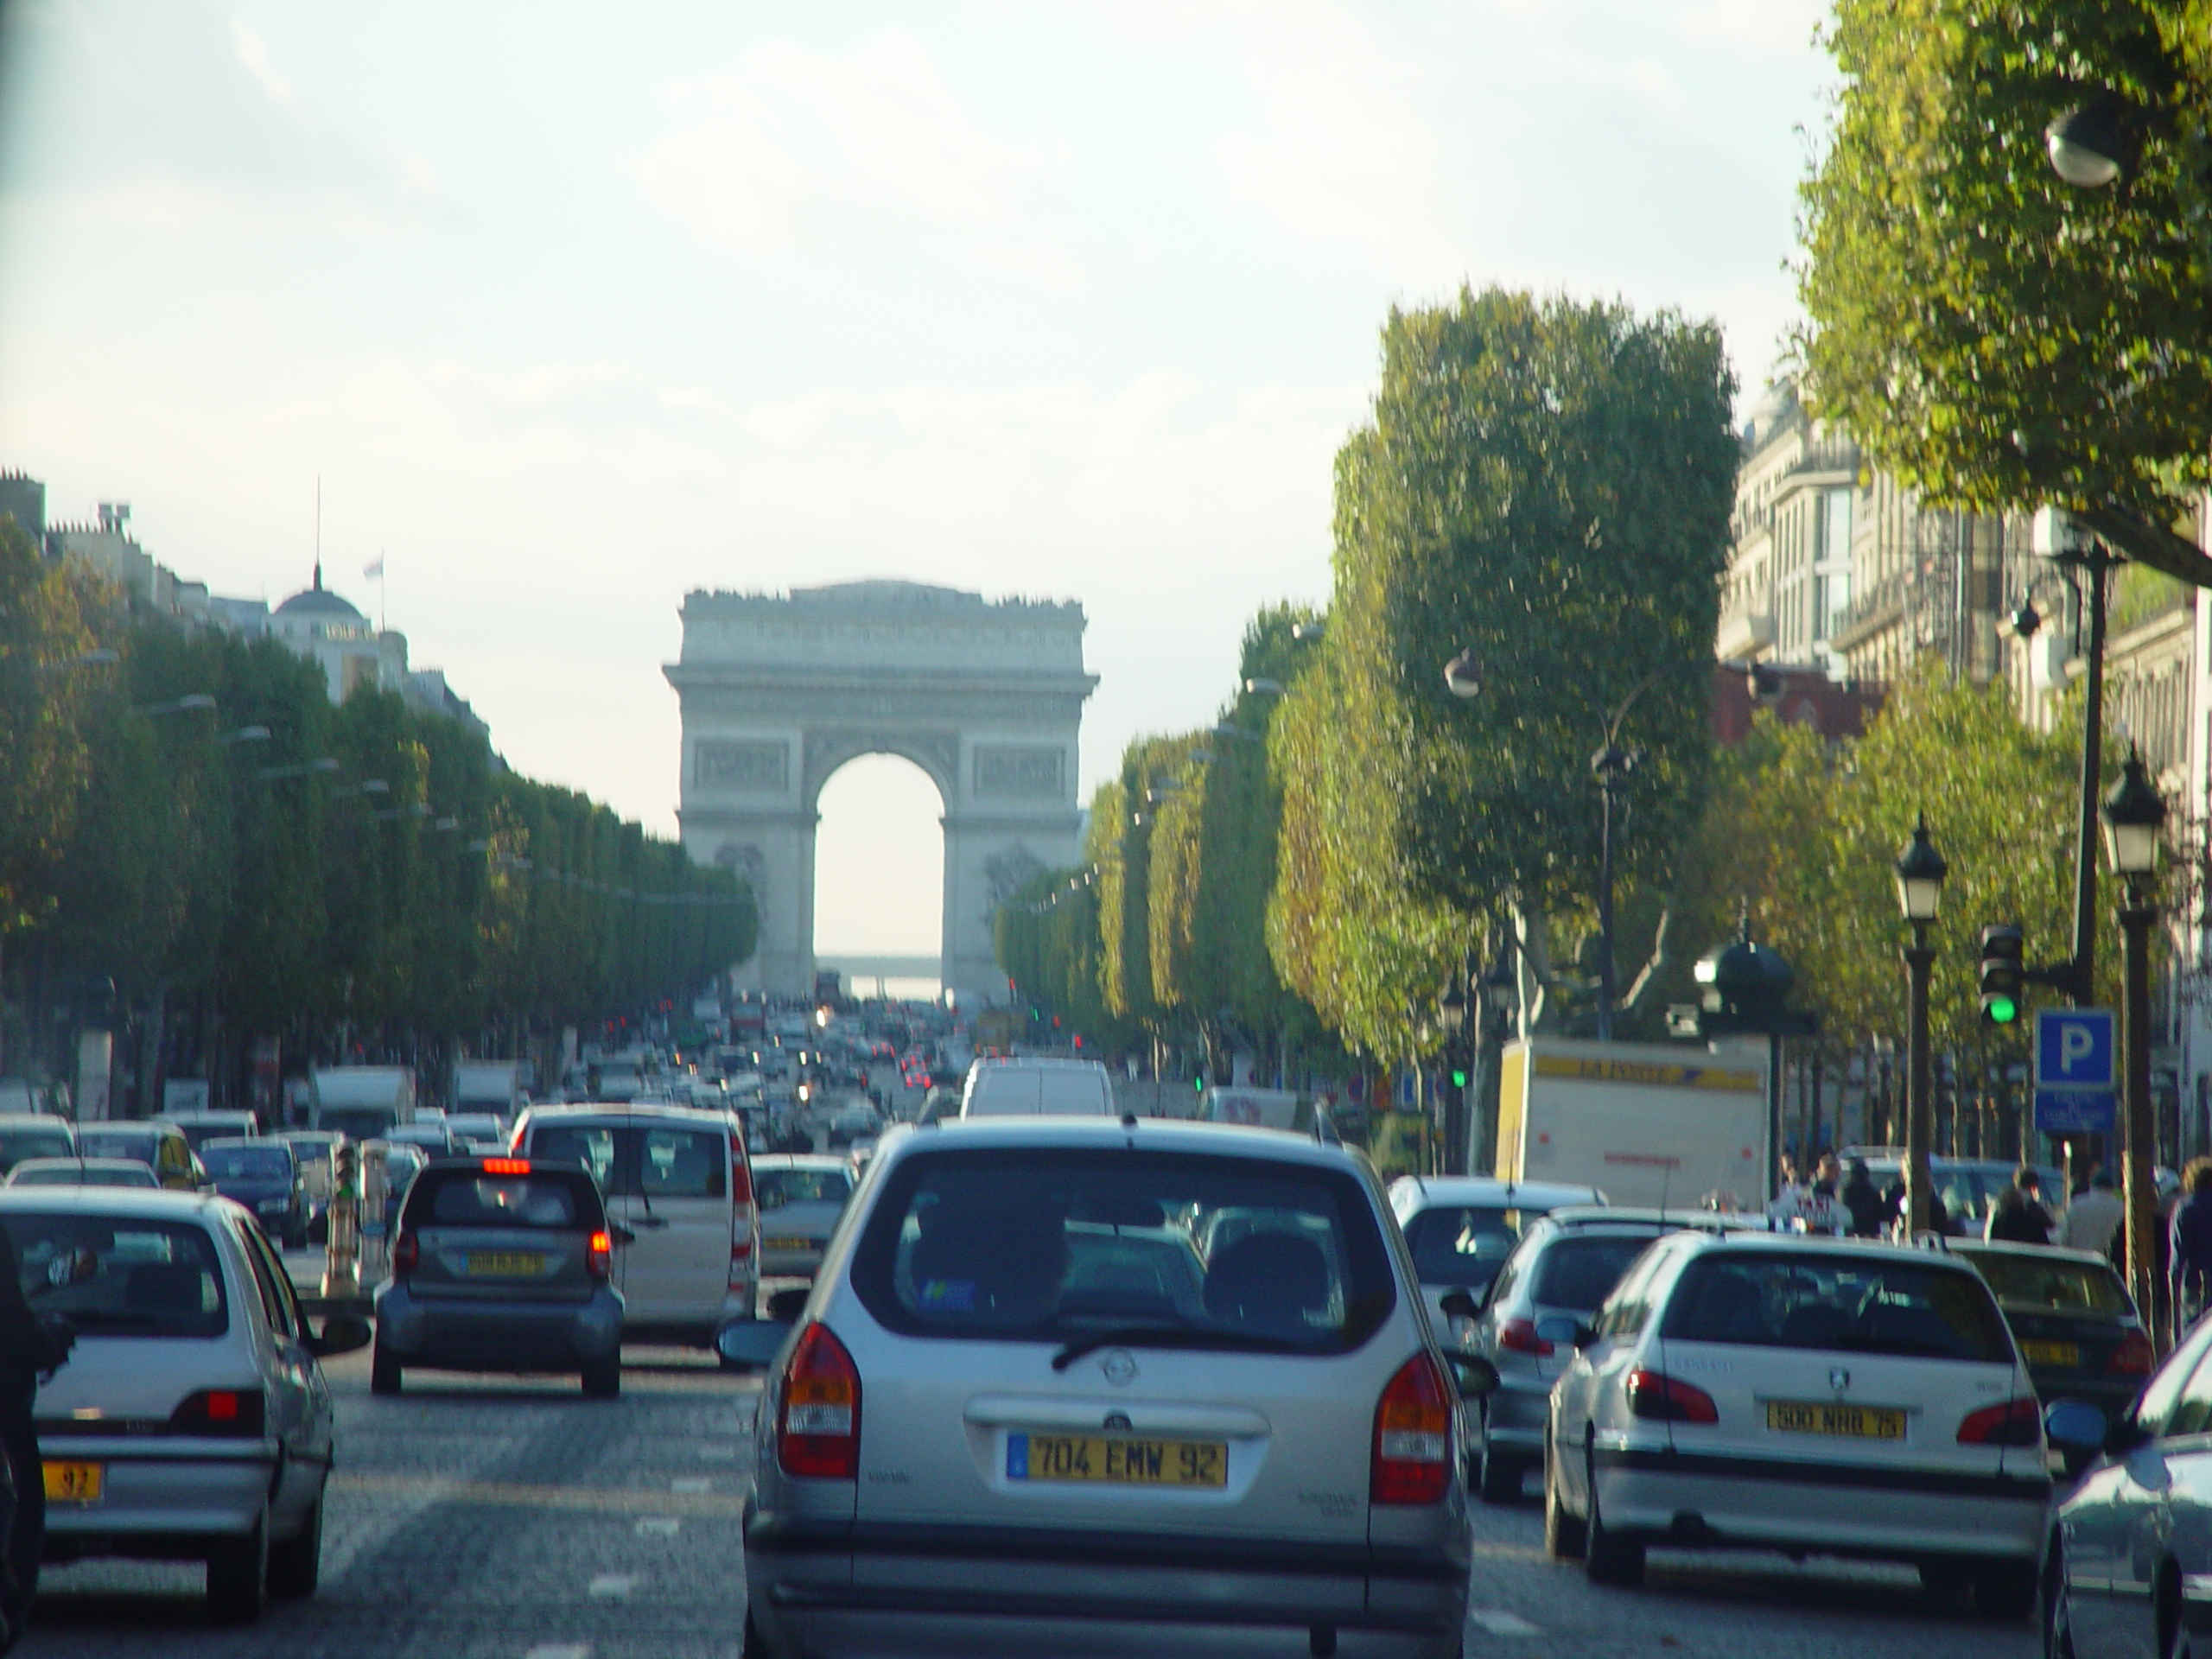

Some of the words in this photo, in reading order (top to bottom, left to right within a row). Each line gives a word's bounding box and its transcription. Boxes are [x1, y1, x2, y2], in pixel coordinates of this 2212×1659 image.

[2061, 1023, 2094, 1074] P
[1035, 1435, 1092, 1476] 704
[1105, 1440, 1164, 1478] EMW
[1179, 1444, 1218, 1483] 92
